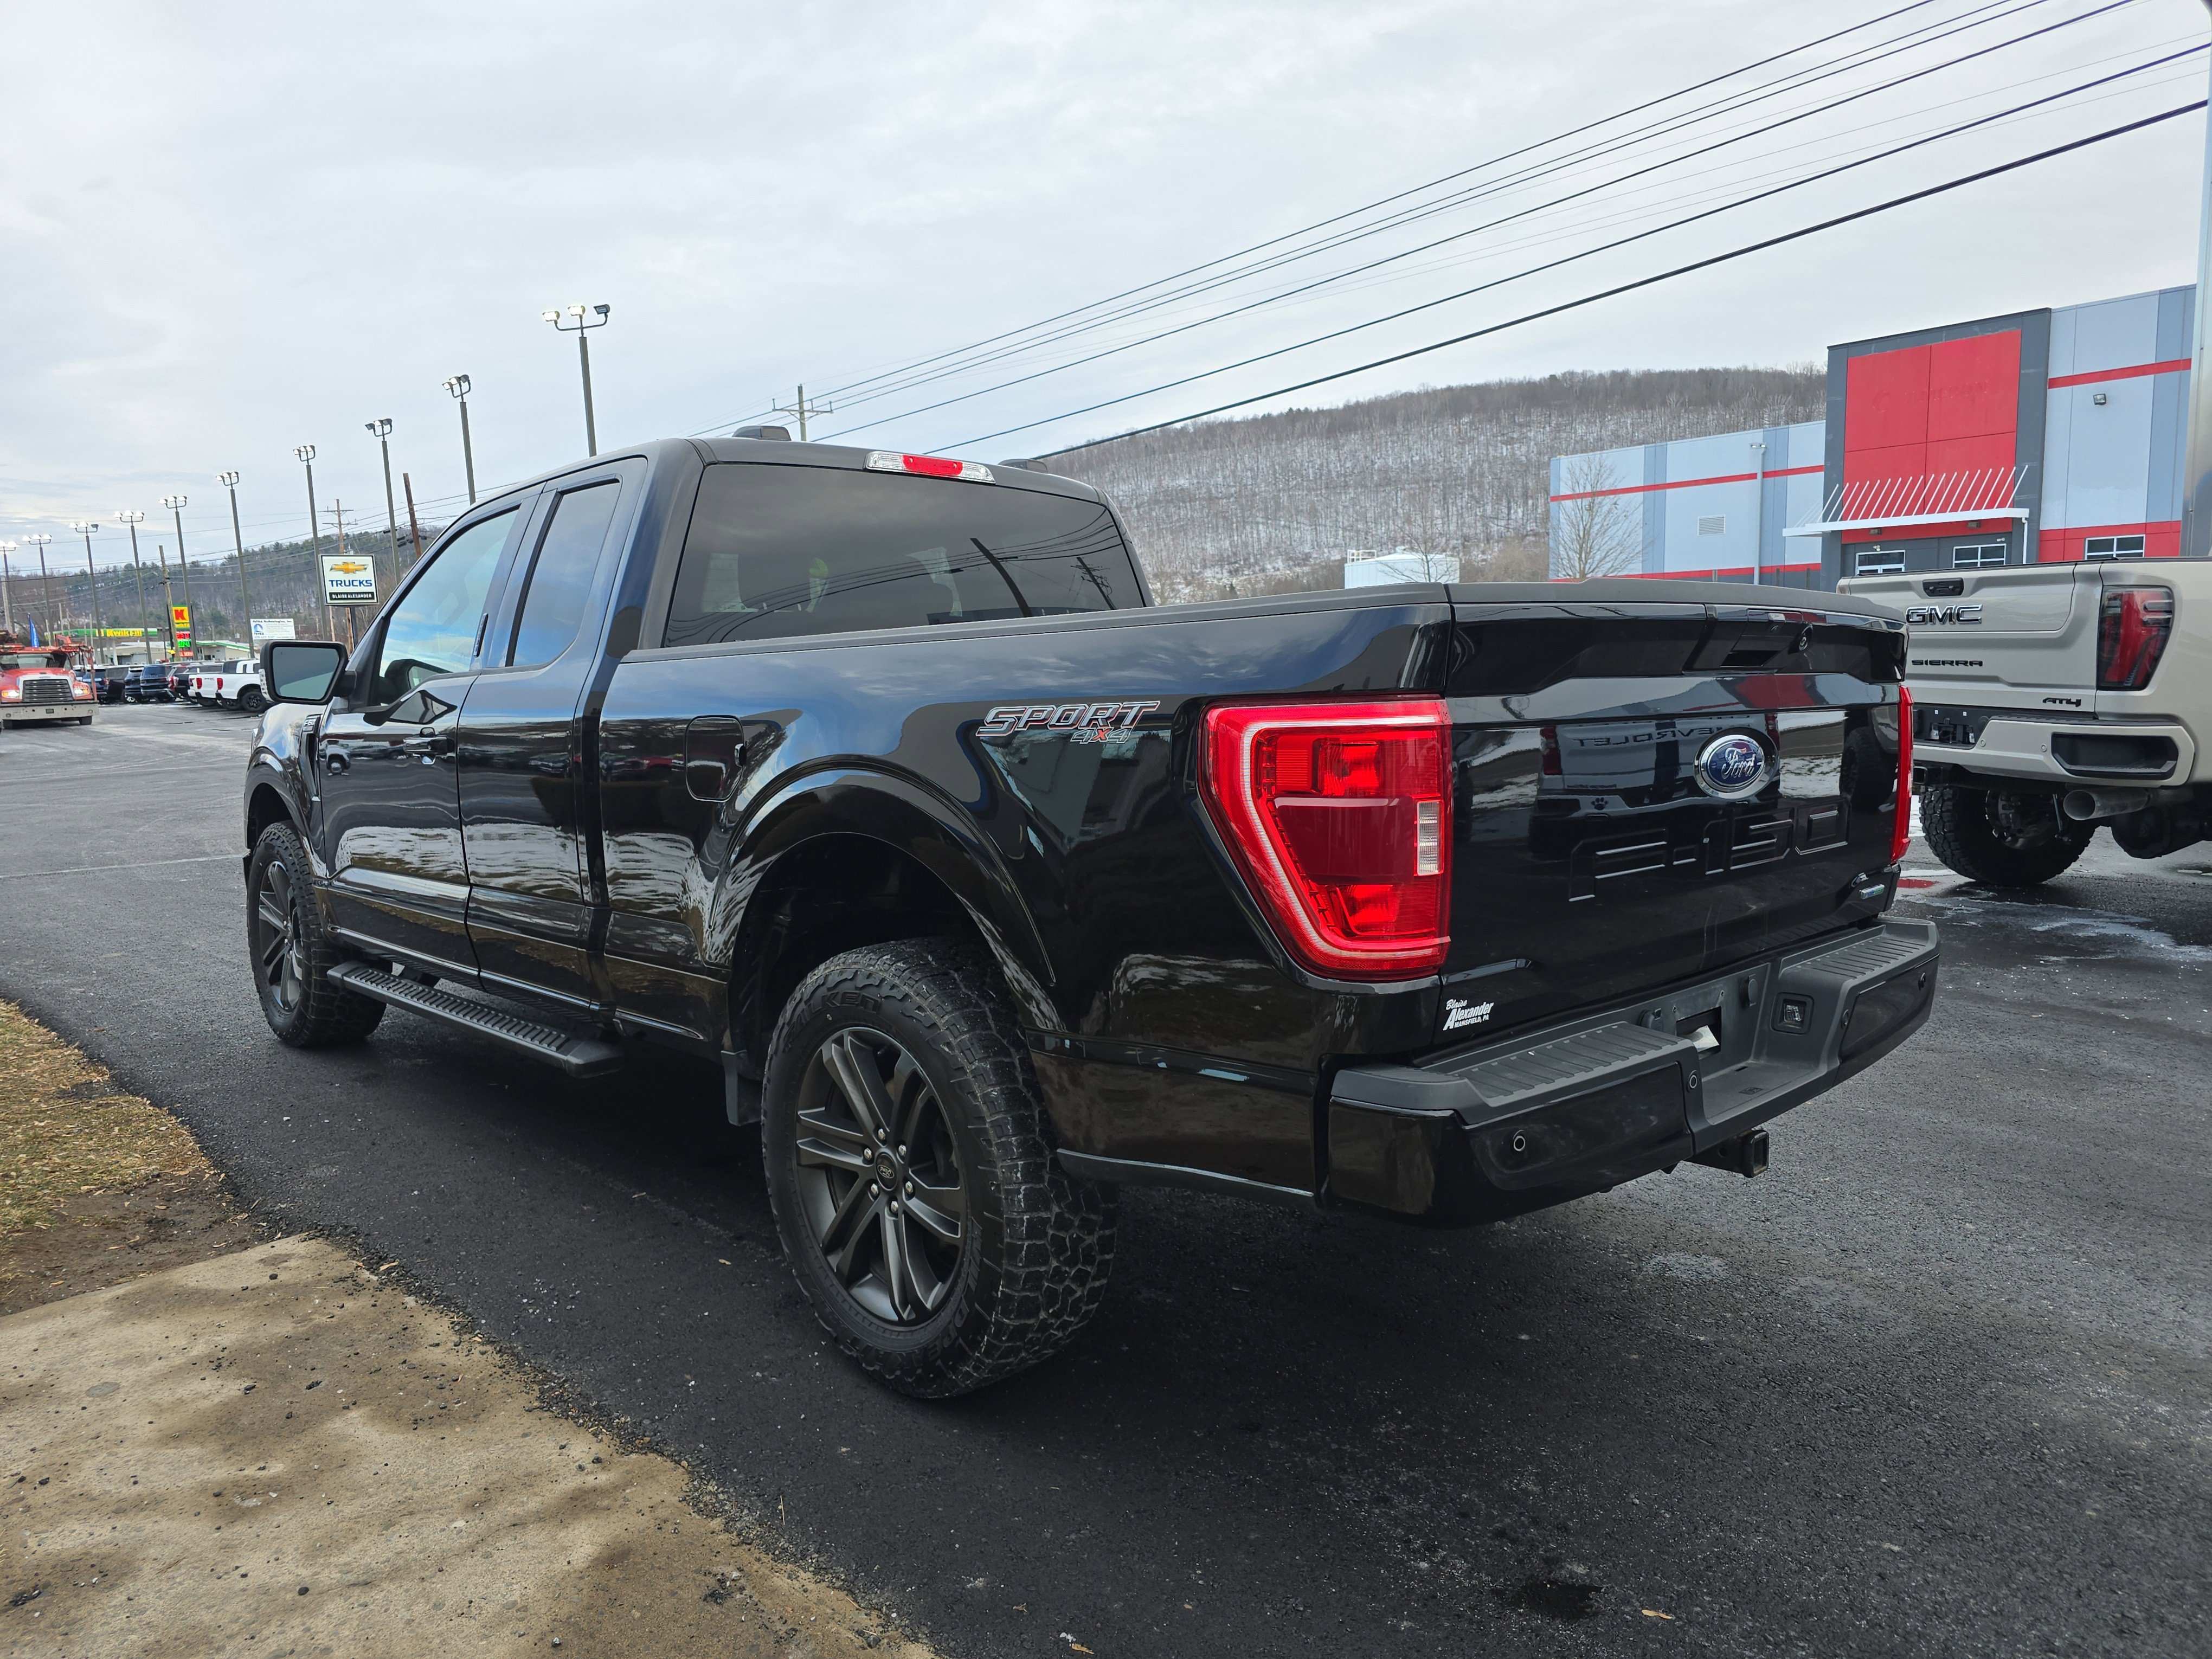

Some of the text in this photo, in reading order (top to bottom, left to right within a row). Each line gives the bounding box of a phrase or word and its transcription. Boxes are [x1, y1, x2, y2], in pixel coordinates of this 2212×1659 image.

[174, 609, 187, 621] K
[1906, 604, 1983, 624] GMC
[2042, 697, 2081, 707] AT4
[976, 700, 1160, 736] SPORT
[1721, 747, 1761, 780] Ford
[1568, 798, 1852, 902] F-150
[1446, 999, 1467, 1010] Blaise
[1443, 1001, 1494, 1031] Alexander
[1454, 1016, 1482, 1028] MANSFIELD,
